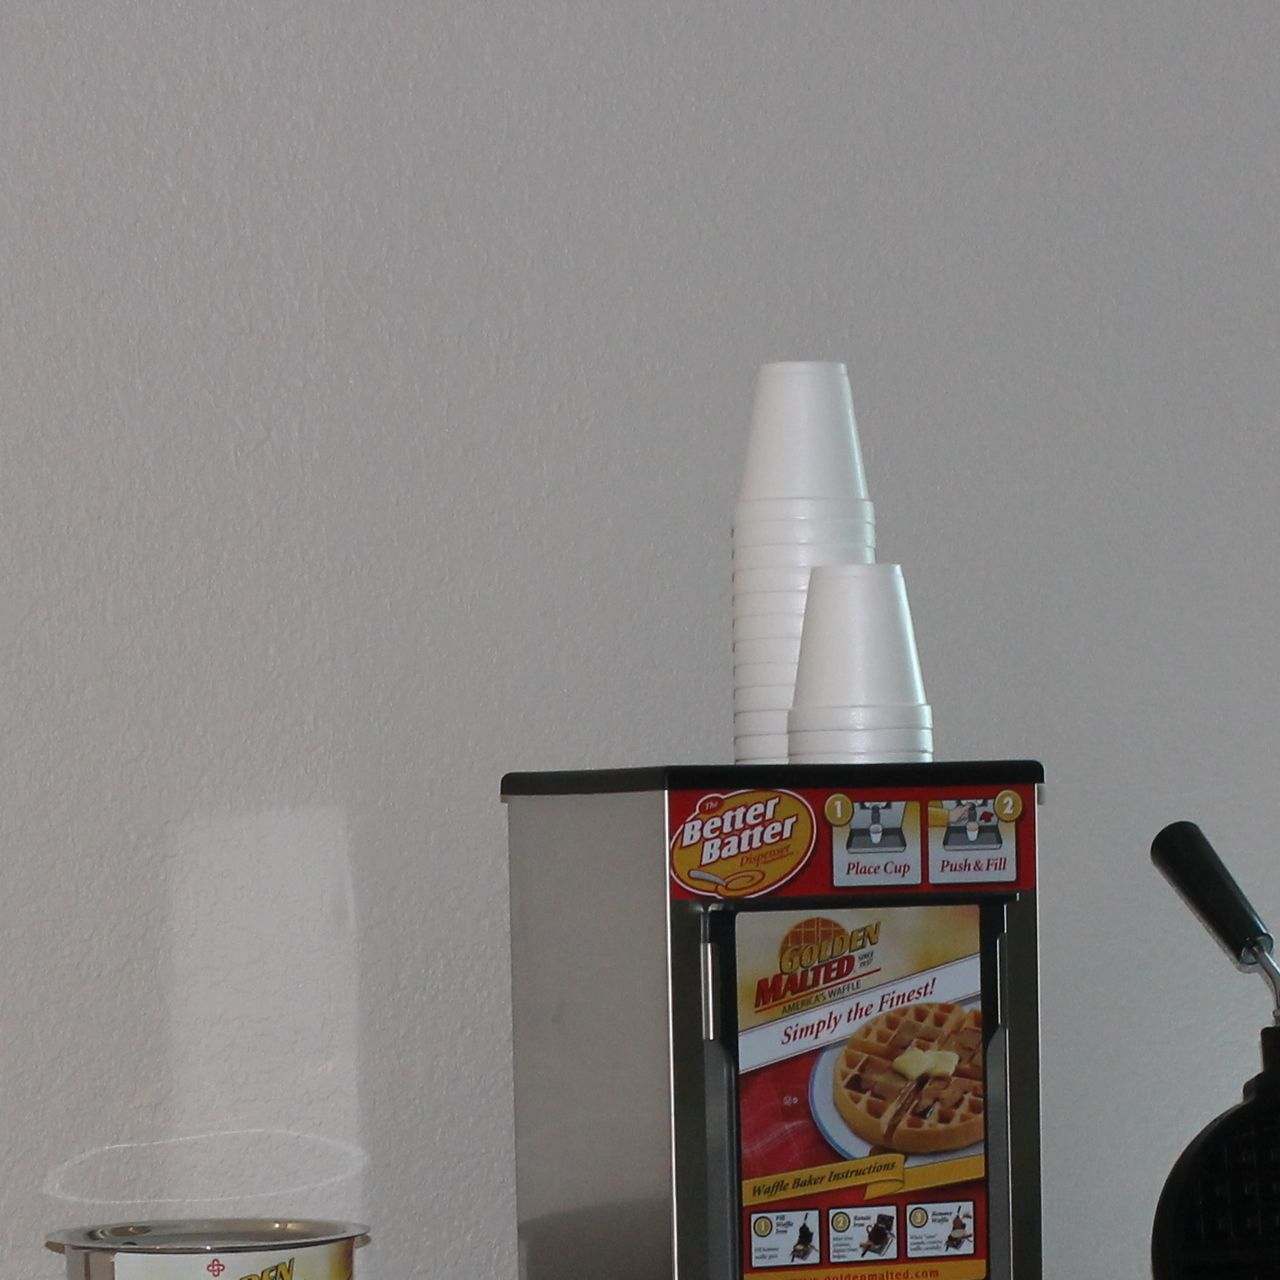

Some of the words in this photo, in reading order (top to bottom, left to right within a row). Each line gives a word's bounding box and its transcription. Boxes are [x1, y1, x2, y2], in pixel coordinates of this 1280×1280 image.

[682, 796, 779, 848] Better
[703, 800, 719, 811] The
[833, 801, 843, 818] 1
[1003, 798, 1014, 814] 2
[700, 812, 798, 866] Batter
[739, 844, 792, 868] Dispenser
[846, 861, 880, 876] Place
[883, 860, 911, 878] Cup
[940, 858, 973, 873] Push
[973, 860, 984, 872] &
[985, 856, 1007, 872] Fill
[779, 920, 881, 975] GOLDEN
[754, 954, 856, 1008] MALTED
[781, 992, 827, 1014] AMERICA'S
[828, 980, 862, 999] WAFFLE
[781, 1010, 843, 1045] Simply
[847, 1002, 873, 1024] the
[878, 977, 937, 1014] Finest!
[752, 1181, 790, 1198] Waffle
[792, 1174, 827, 1190] Baker
[827, 1160, 897, 1182] Instructions
